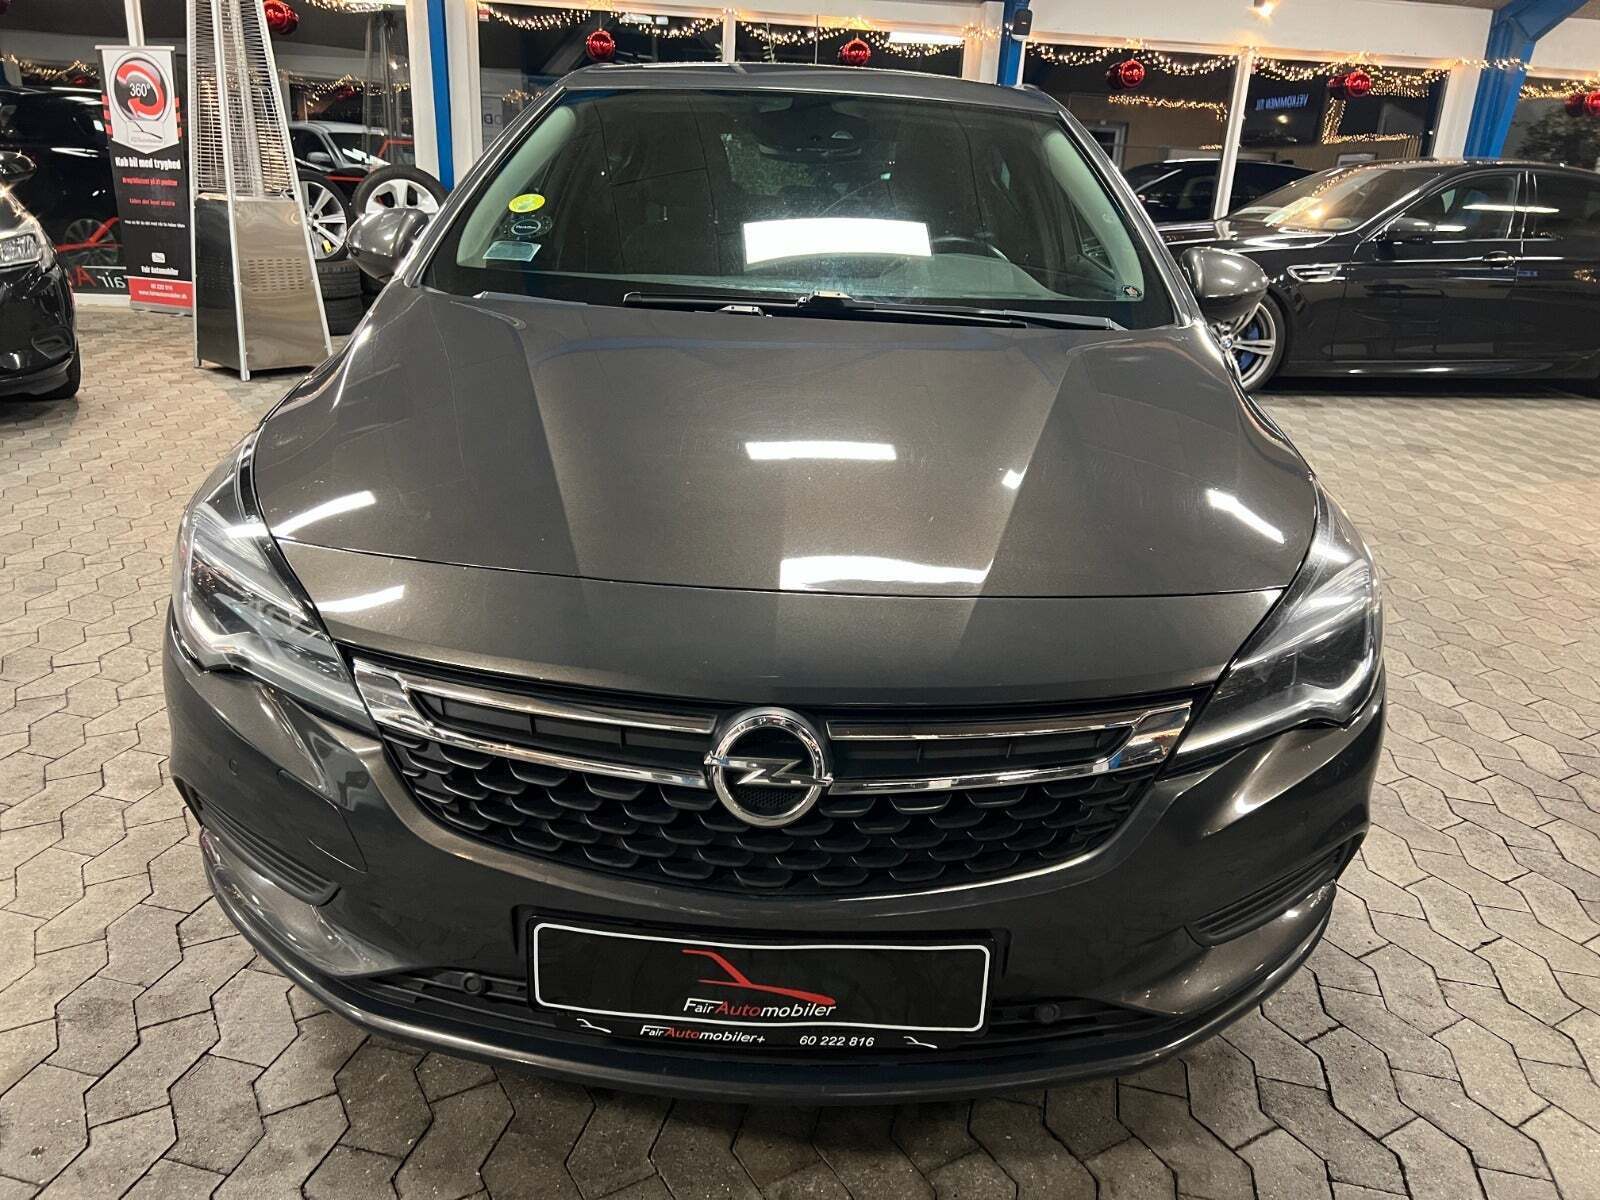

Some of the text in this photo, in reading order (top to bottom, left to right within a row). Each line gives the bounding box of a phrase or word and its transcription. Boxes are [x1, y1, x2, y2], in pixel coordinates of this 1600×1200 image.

[129, 83, 151, 97] 360°
[799, 1035, 817, 1046] 60
[820, 1035, 846, 1046] 222
[848, 1036, 875, 1047] 816
